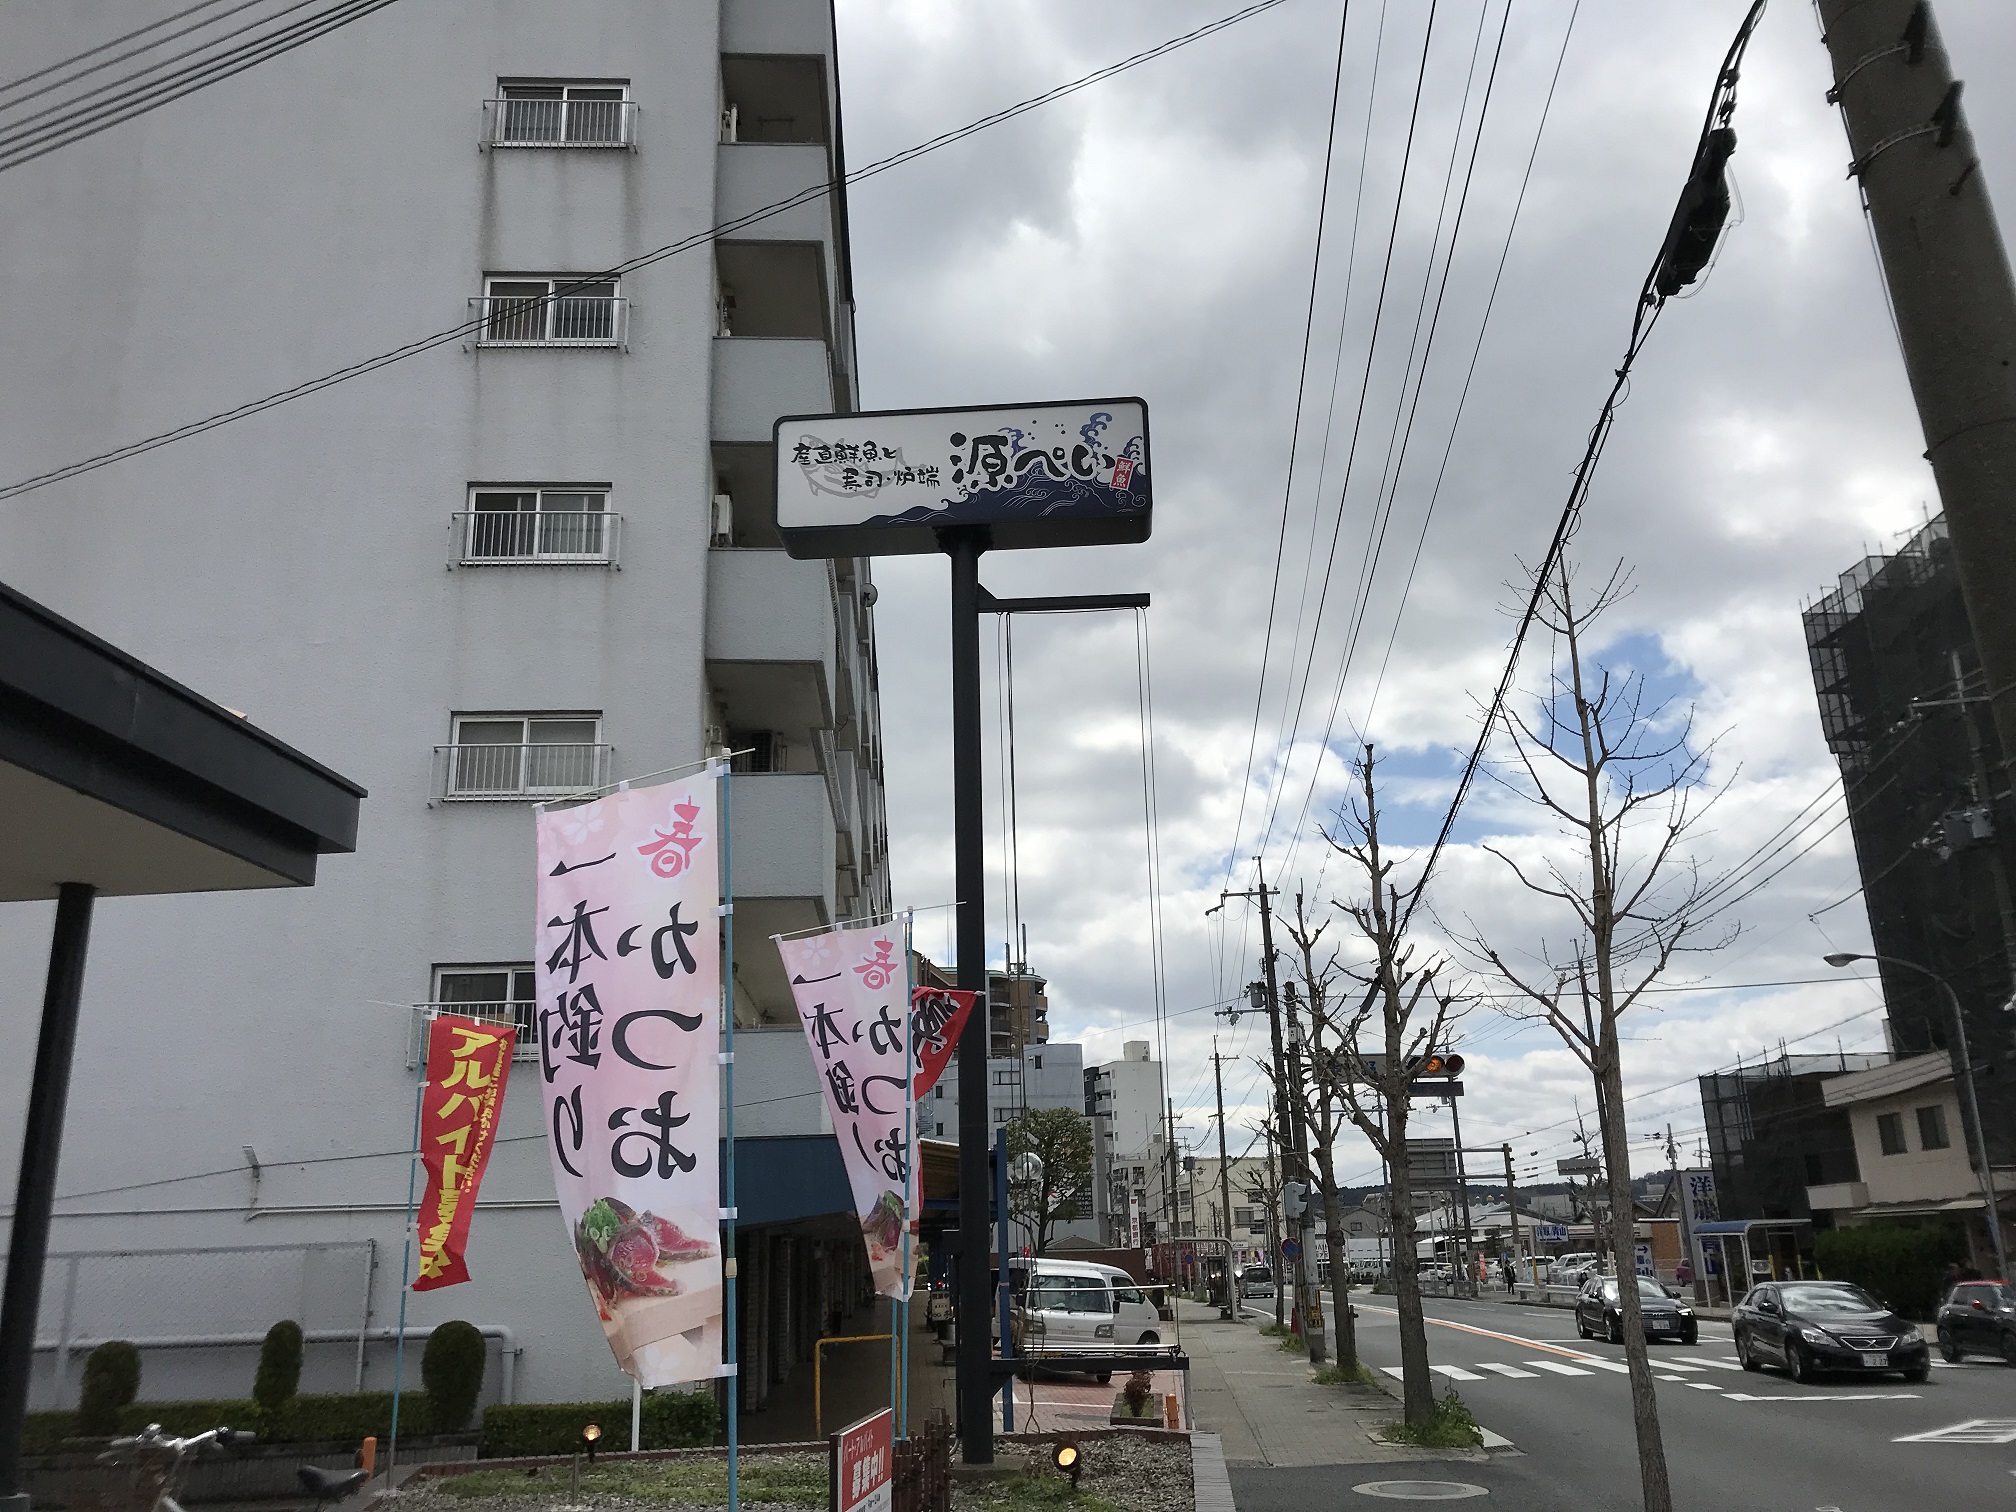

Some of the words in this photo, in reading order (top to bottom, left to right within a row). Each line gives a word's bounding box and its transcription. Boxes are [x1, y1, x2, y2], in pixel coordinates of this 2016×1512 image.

[790, 440, 897, 466] 産直鮮魚と
